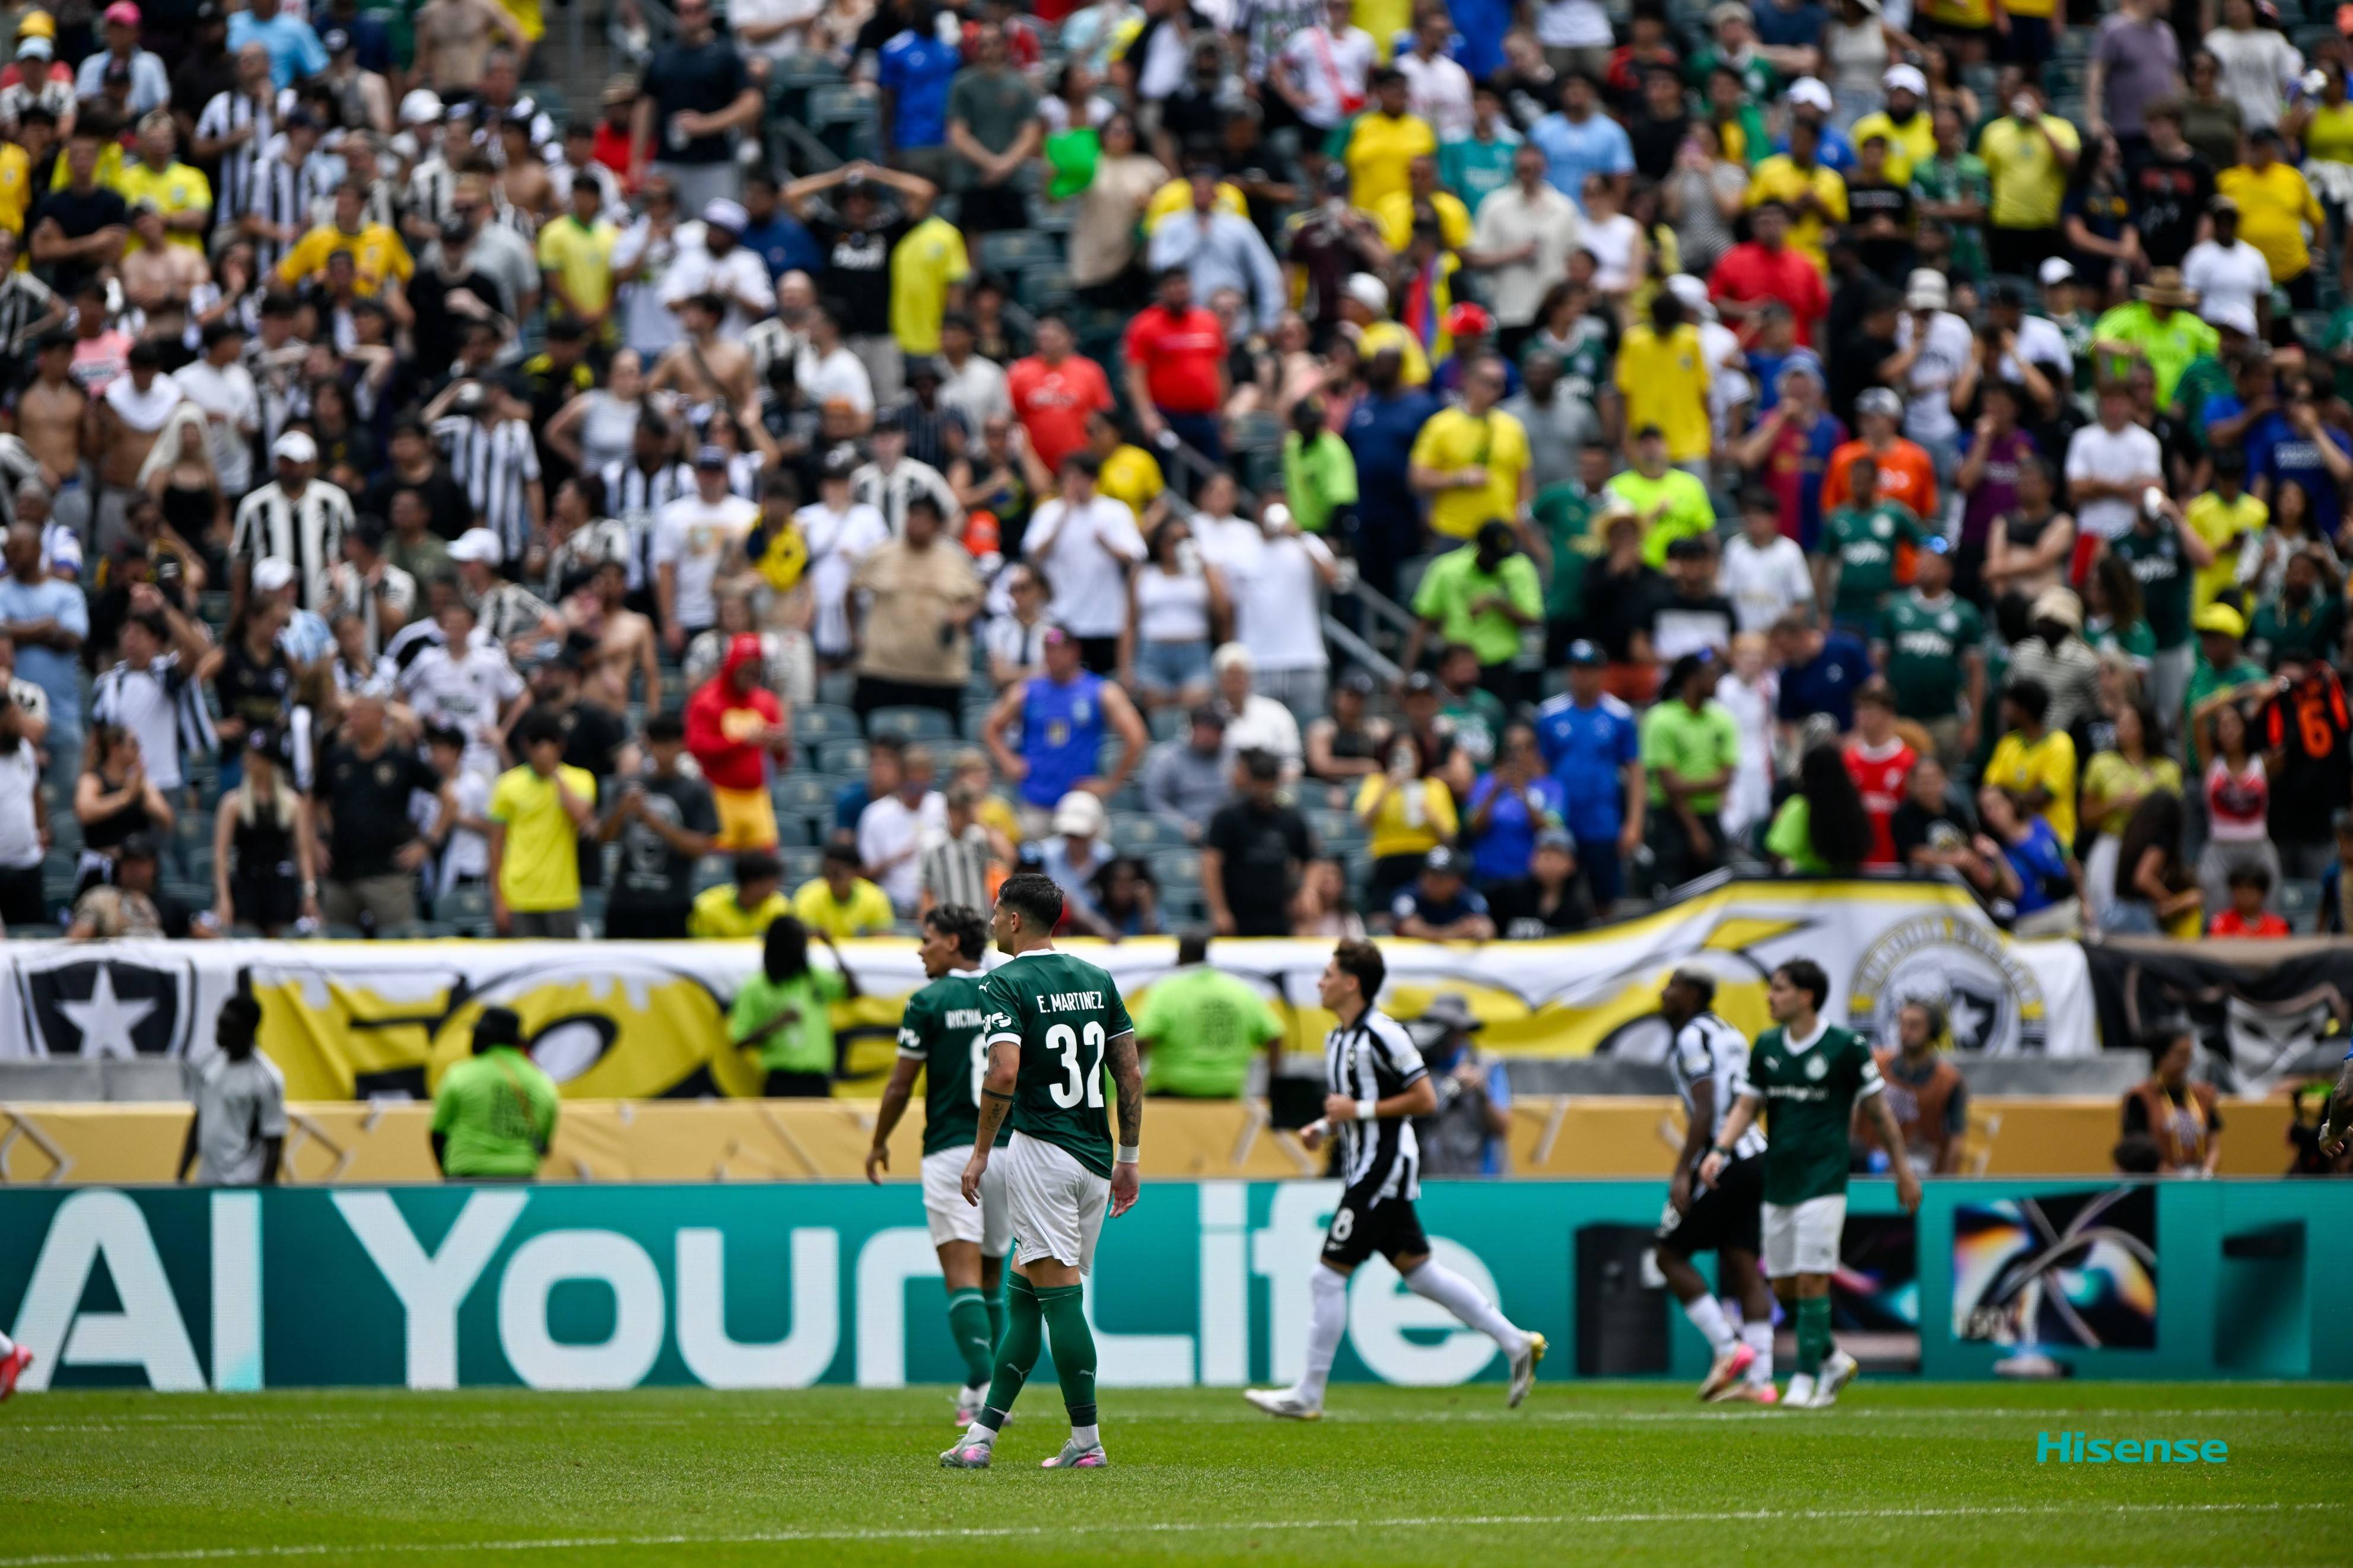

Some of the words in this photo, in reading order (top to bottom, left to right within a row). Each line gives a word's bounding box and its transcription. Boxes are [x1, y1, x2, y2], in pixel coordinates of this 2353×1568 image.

[1050, 991, 1105, 1012] MARTINEZ
[1045, 1020, 1105, 1108] 32
[1332, 1207, 1354, 1242] 8
[8, 1187, 263, 1391] AI
[327, 1188, 947, 1390] Your
